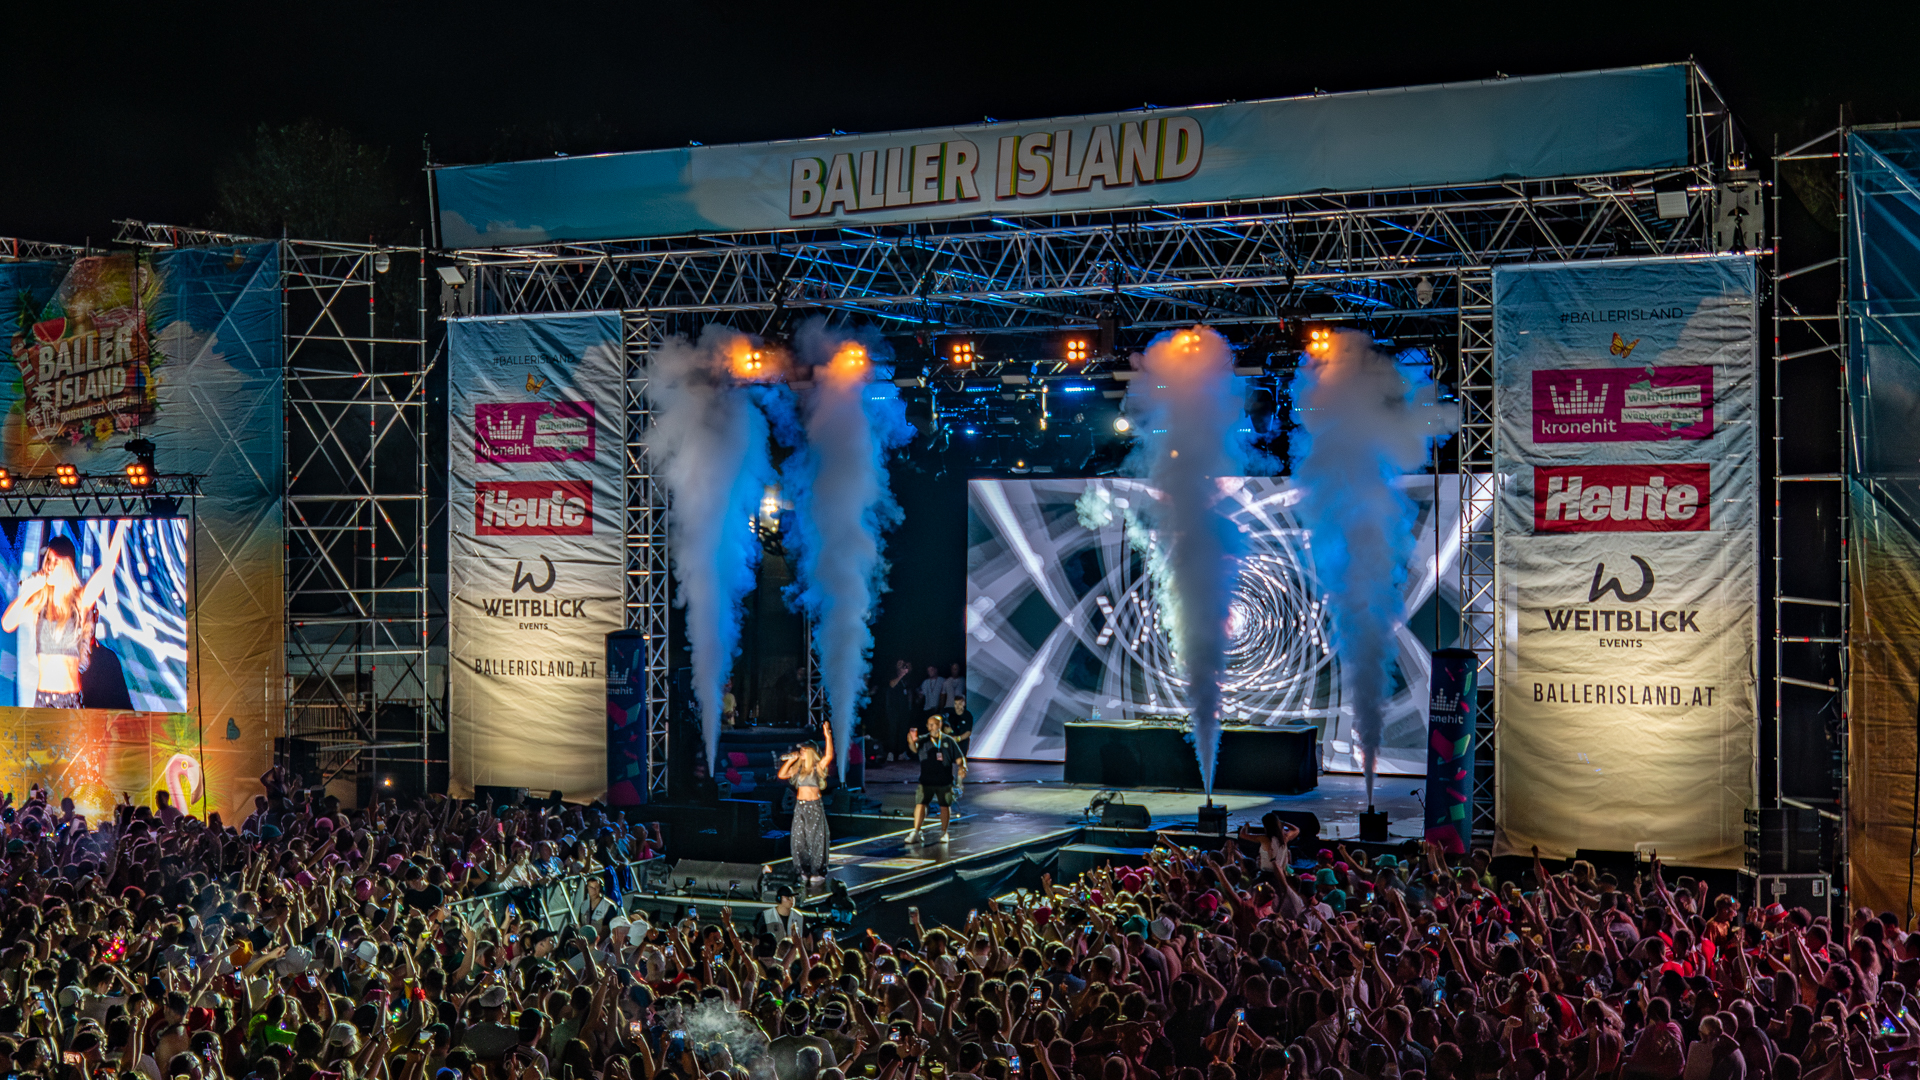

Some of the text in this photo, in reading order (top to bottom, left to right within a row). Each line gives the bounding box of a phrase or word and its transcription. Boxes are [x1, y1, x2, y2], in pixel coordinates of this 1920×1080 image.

[789, 115, 1204, 219] BALLER ISLAND
[1560, 307, 1683, 324] #BALLERISLAND
[38, 327, 134, 383] BALLER
[493, 353, 575, 366] #BALLERISLAND
[54, 367, 126, 407] ISLAND
[1541, 419, 1617, 434] kronehit
[480, 443, 531, 456] kronehit
[1545, 476, 1699, 521] Heute
[482, 490, 586, 527] Heute
[482, 599, 586, 617] WEITBLICK
[1543, 609, 1700, 633] WEITBLICK
[1599, 638, 1643, 648] EVENTS
[475, 659, 597, 678] BALLERISLAND.AT
[606, 686, 634, 695] onehit
[1533, 682, 1715, 707] BALLERISLAND.AT
[1430, 714, 1464, 725] onehit
